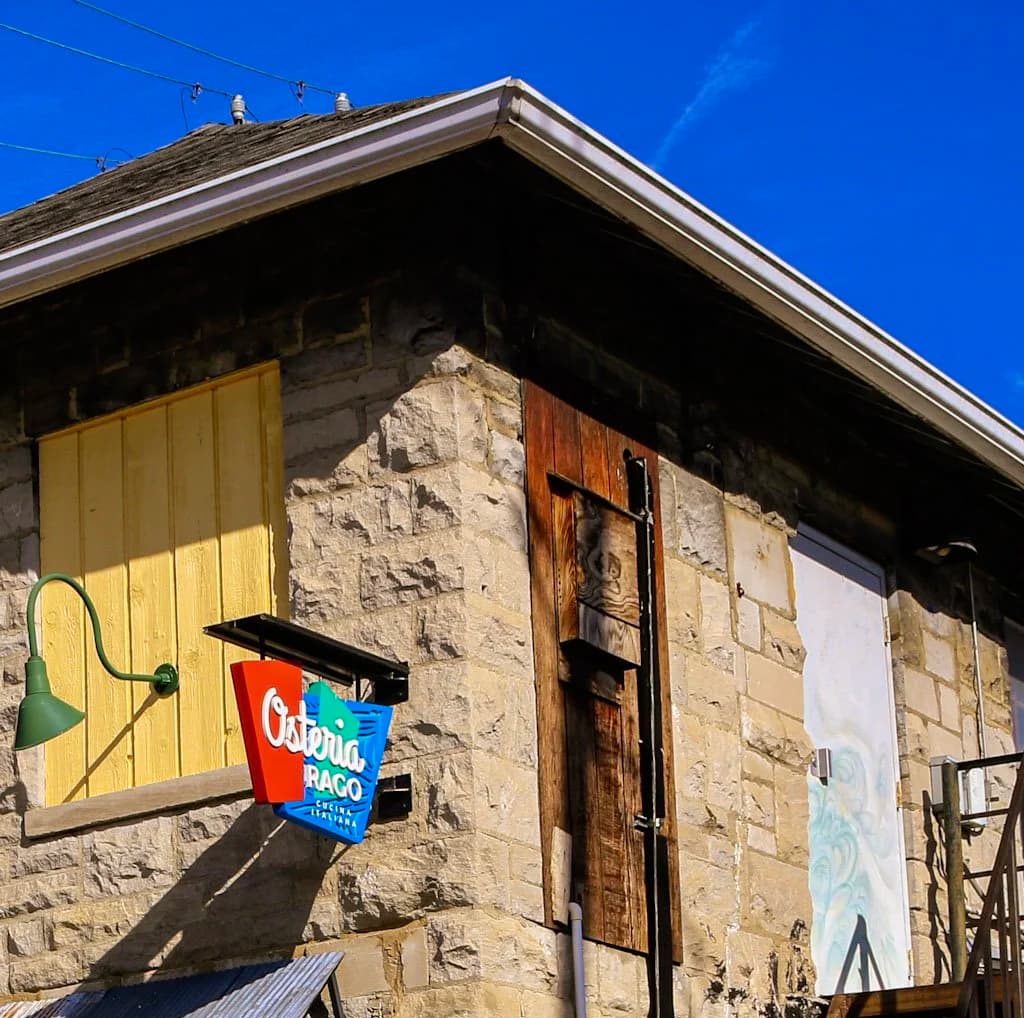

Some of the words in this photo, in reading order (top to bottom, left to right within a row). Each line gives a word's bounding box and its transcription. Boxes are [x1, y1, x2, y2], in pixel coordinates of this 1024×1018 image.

[262, 688, 366, 773] Osteria
[304, 764, 363, 802] RAGO
[311, 809, 357, 827] ITALIANA
[316, 800, 352, 816] CUCINA
